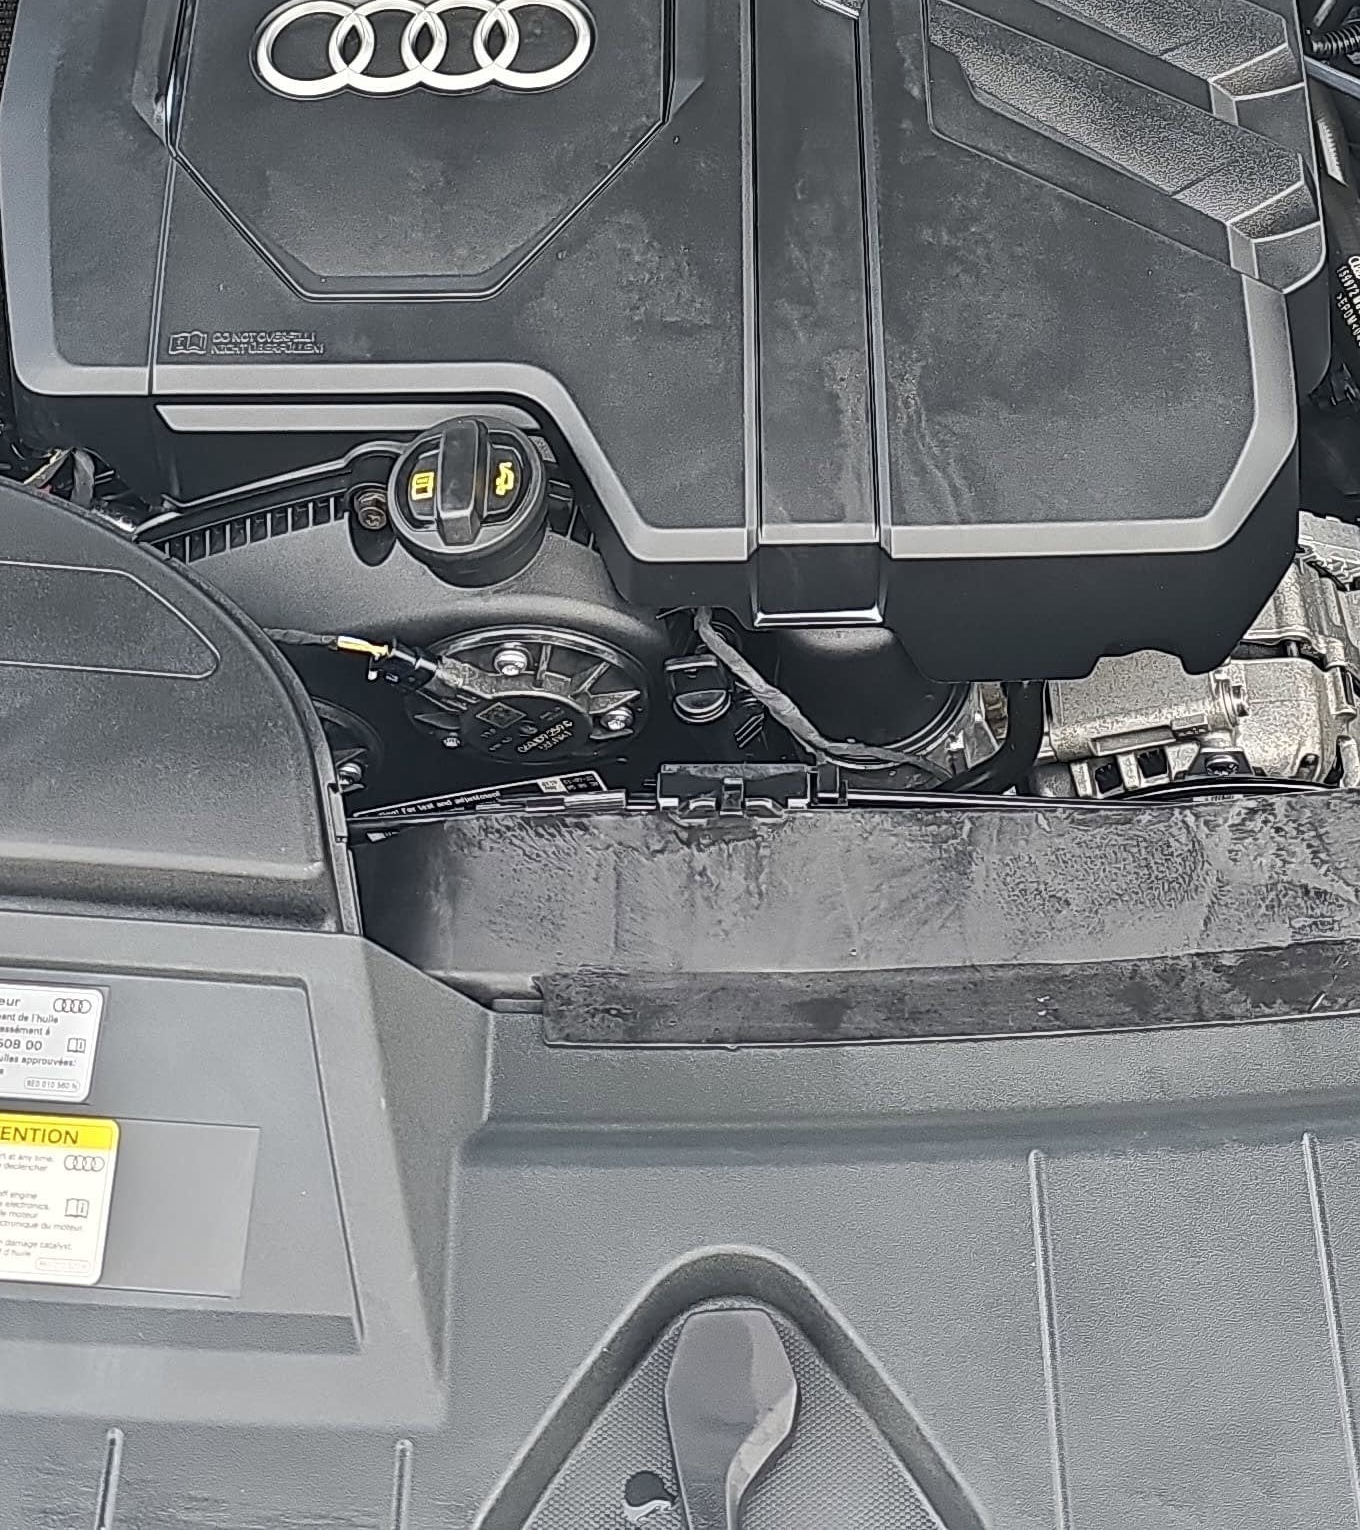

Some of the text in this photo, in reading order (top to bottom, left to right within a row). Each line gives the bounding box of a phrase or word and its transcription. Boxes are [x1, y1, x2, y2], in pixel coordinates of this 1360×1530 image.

[18, 1011, 29, 1021] de
[25, 1039, 42, 1051] 00
[8, 1153, 17, 1161] at
[18, 1154, 33, 1163] any
[10, 1191, 38, 1201] engine
